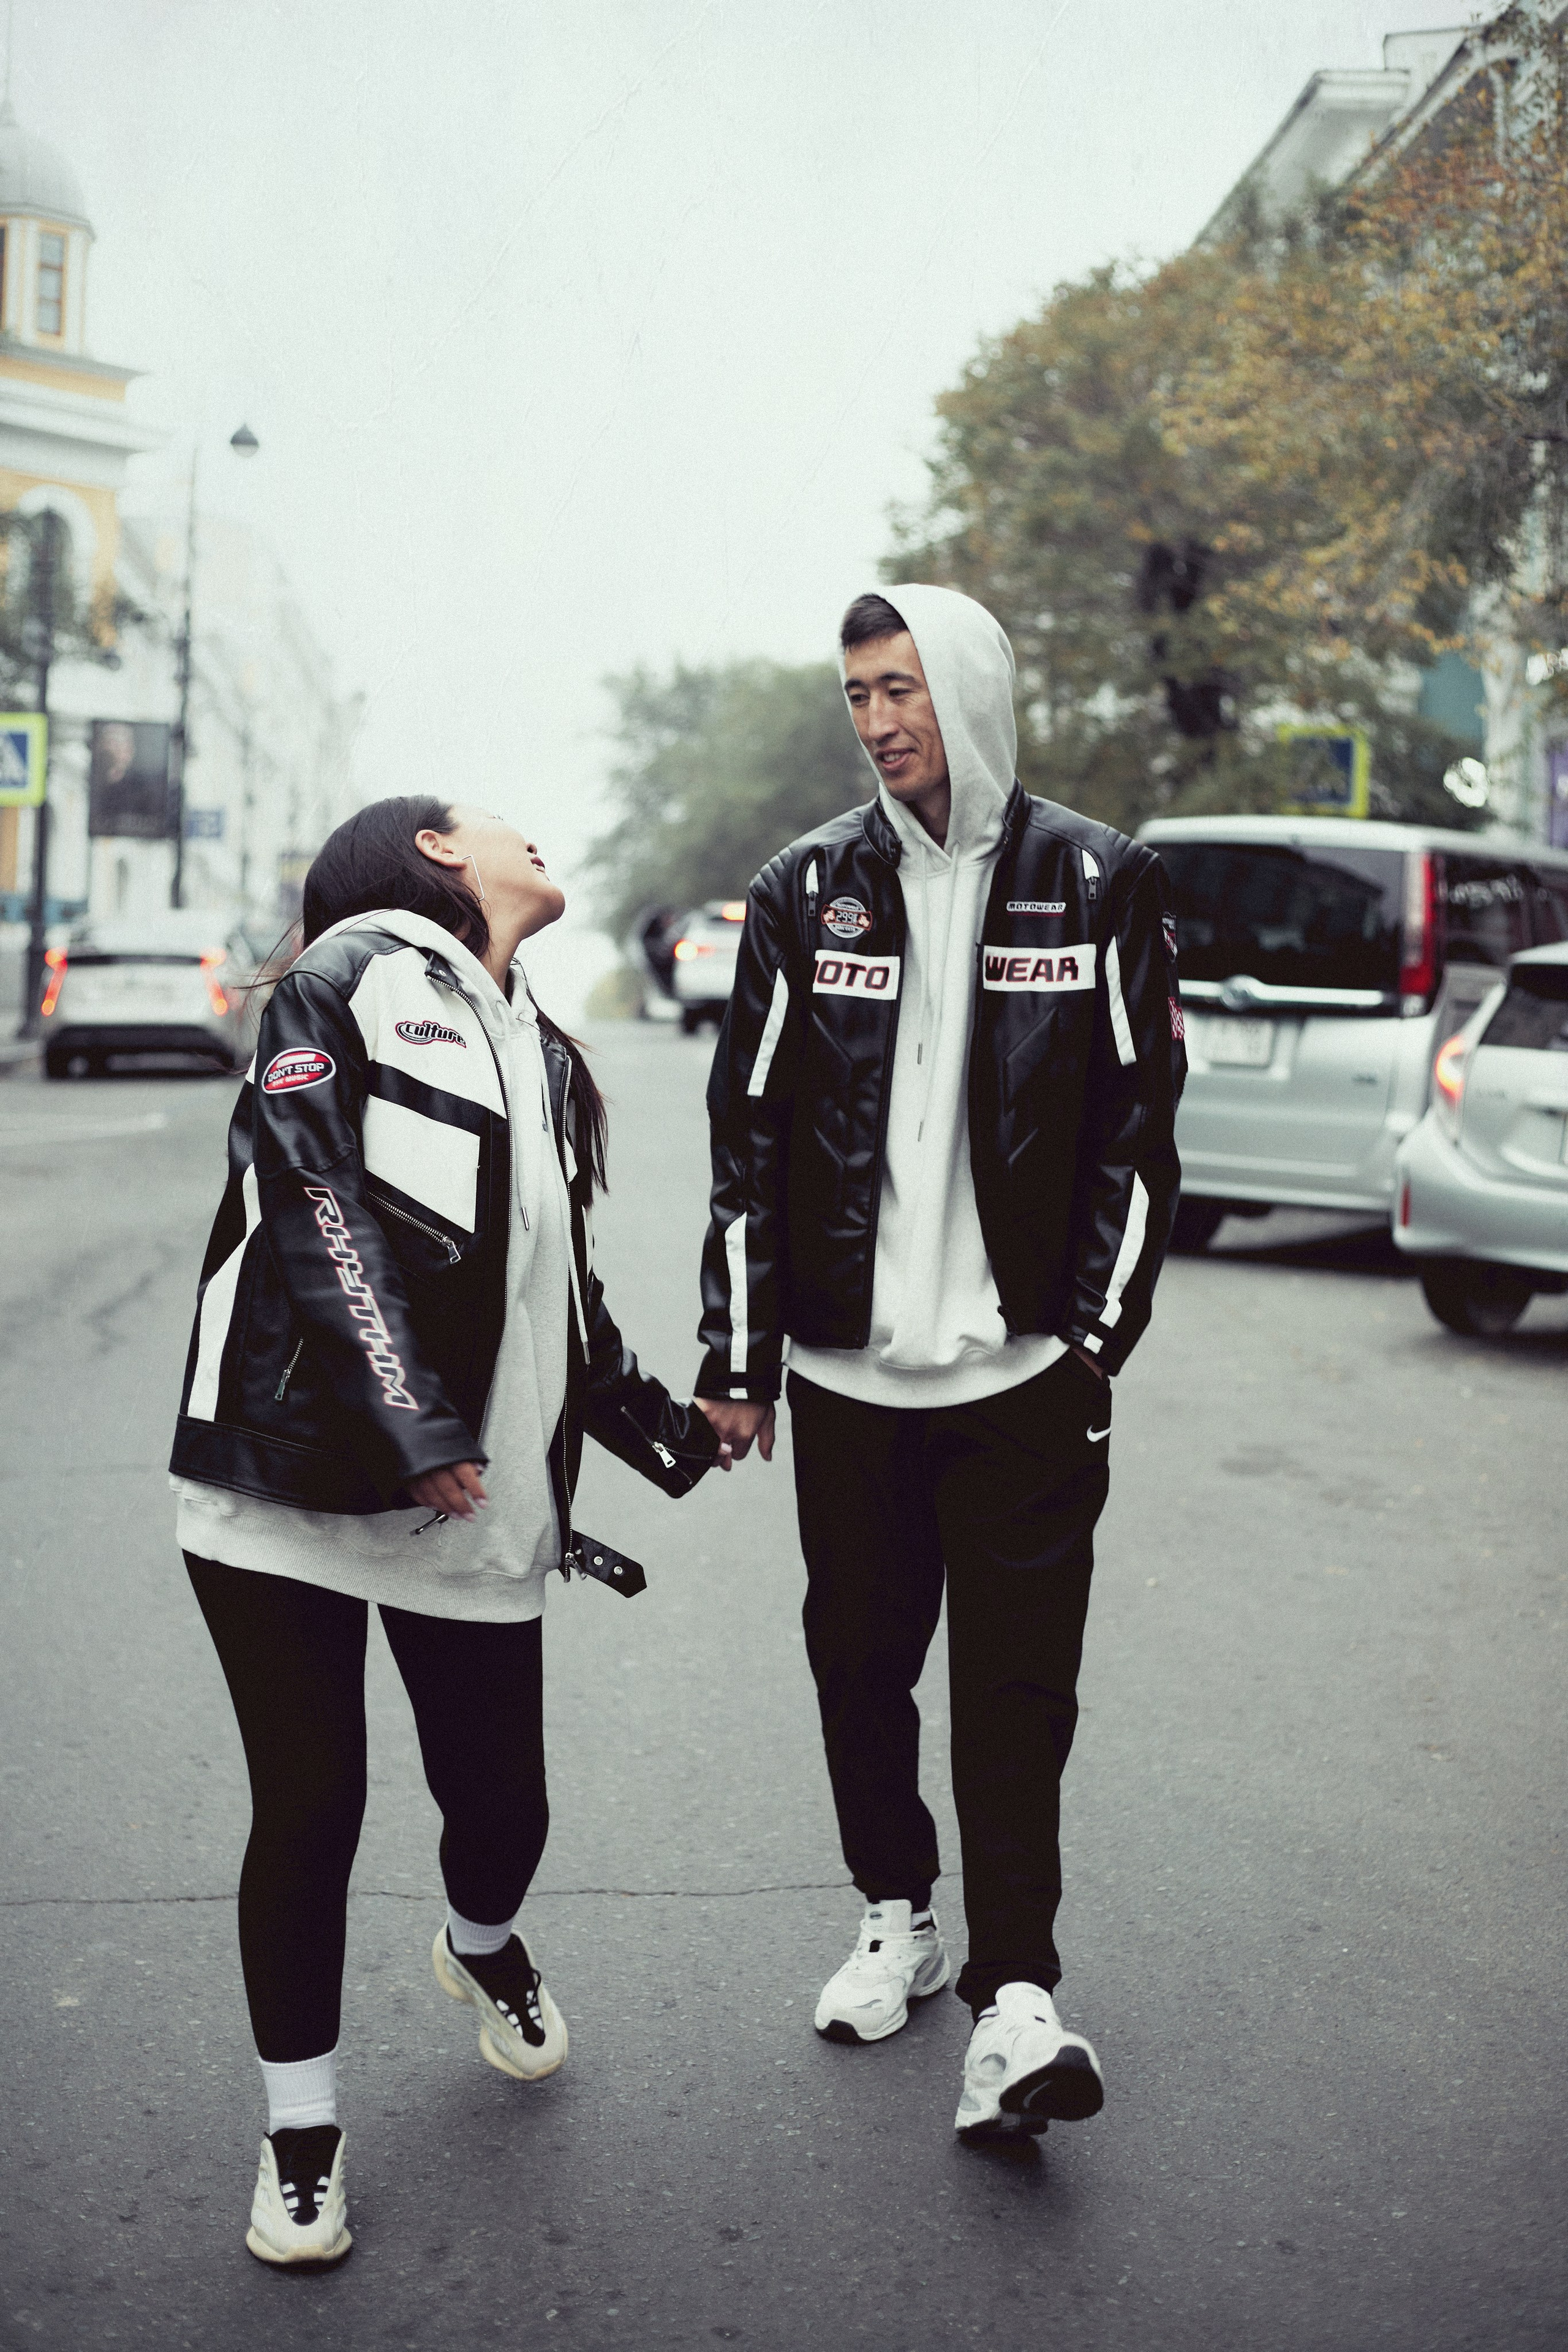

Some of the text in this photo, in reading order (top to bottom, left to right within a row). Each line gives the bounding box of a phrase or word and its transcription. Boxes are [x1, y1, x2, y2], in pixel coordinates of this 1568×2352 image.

[1008, 902, 1065, 911] MOTOWEAR
[815, 956, 1079, 990] OTO WEAR
[268, 1063, 325, 1082] DON'T STOP
[303, 1186, 420, 1410] RHYTHM
